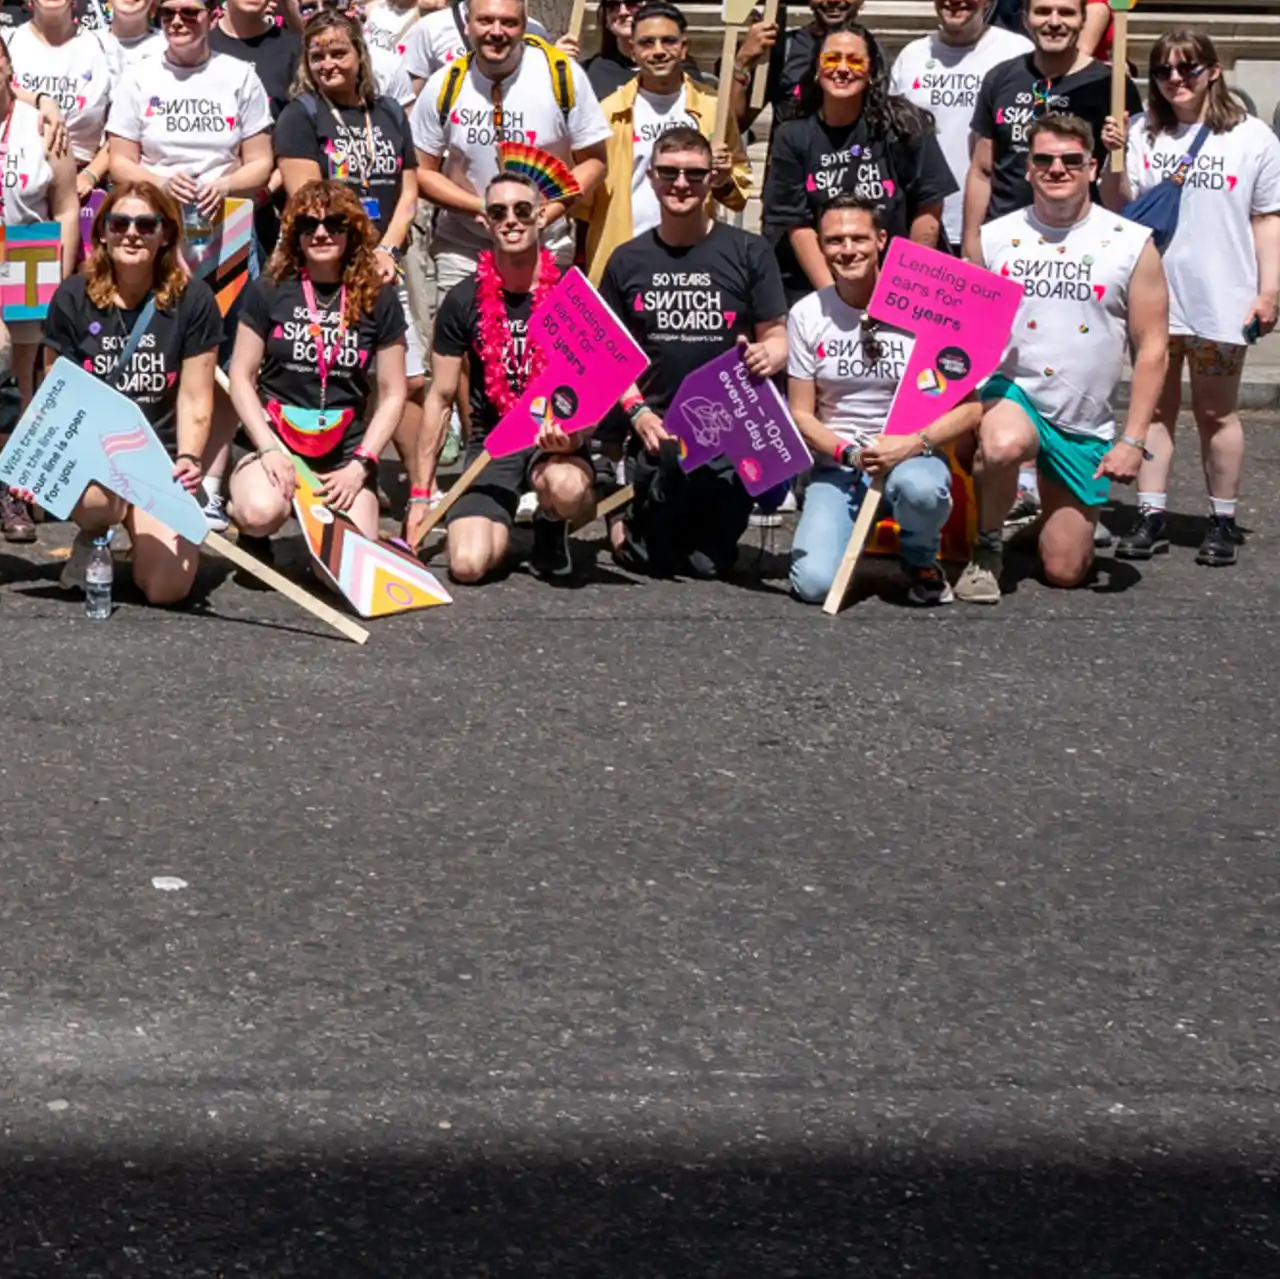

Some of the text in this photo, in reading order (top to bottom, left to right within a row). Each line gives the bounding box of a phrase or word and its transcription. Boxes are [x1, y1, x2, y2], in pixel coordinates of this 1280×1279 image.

[156, 99, 221, 115] SWITCH
[166, 116, 225, 132] BOARD
[652, 273, 711, 286] 50 YEARS
[897, 254, 1002, 302] Lending our
[1012, 259, 1091, 281] SWITCH
[644, 290, 721, 311] SWITCH
[891, 275, 963, 308] ears for
[1023, 280, 1091, 301] BOARD
[552, 300, 596, 355] ears for
[565, 283, 628, 364] Lending our
[657, 311, 723, 330] BOARD
[884, 292, 962, 331] 50 years
[542, 314, 562, 338] 50
[552, 335, 586, 377] years
[719, 371, 767, 451] every day
[764, 419, 792, 462] 10pm
